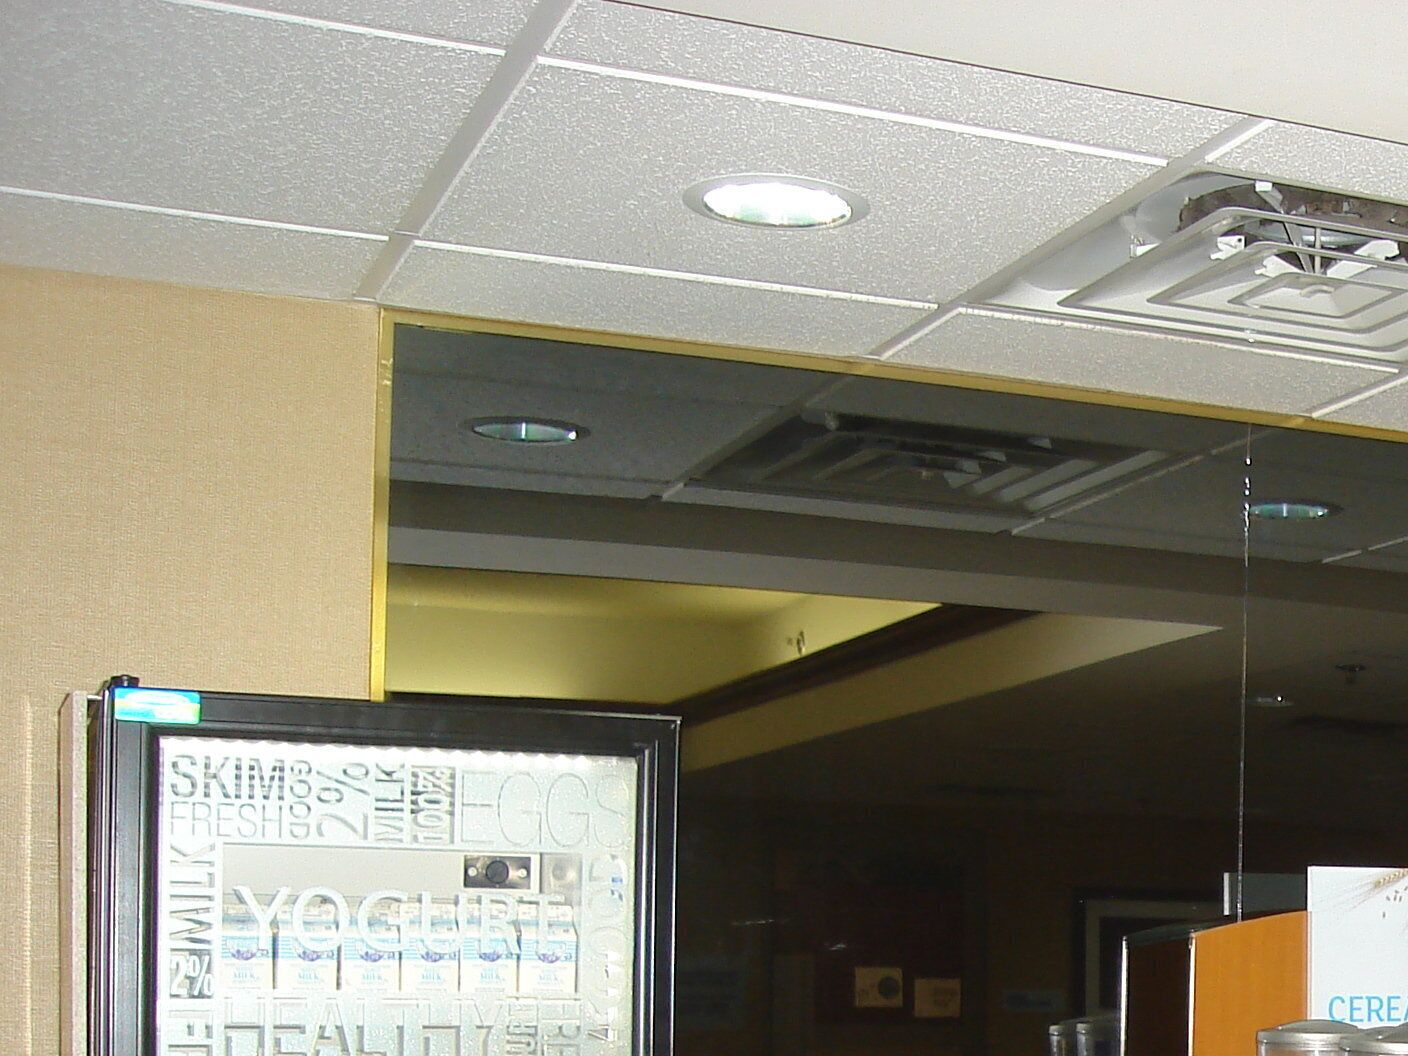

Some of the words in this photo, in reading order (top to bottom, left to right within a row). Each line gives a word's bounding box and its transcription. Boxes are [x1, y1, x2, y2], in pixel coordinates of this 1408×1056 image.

[170, 754, 286, 801] SKIM
[316, 762, 369, 840] 2%
[374, 762, 405, 842] MILK
[461, 770, 633, 848] EGGS
[169, 801, 284, 839] FRESH
[169, 842, 215, 948] MILK
[232, 885, 567, 956] YOGURT
[169, 953, 213, 997] 2%
